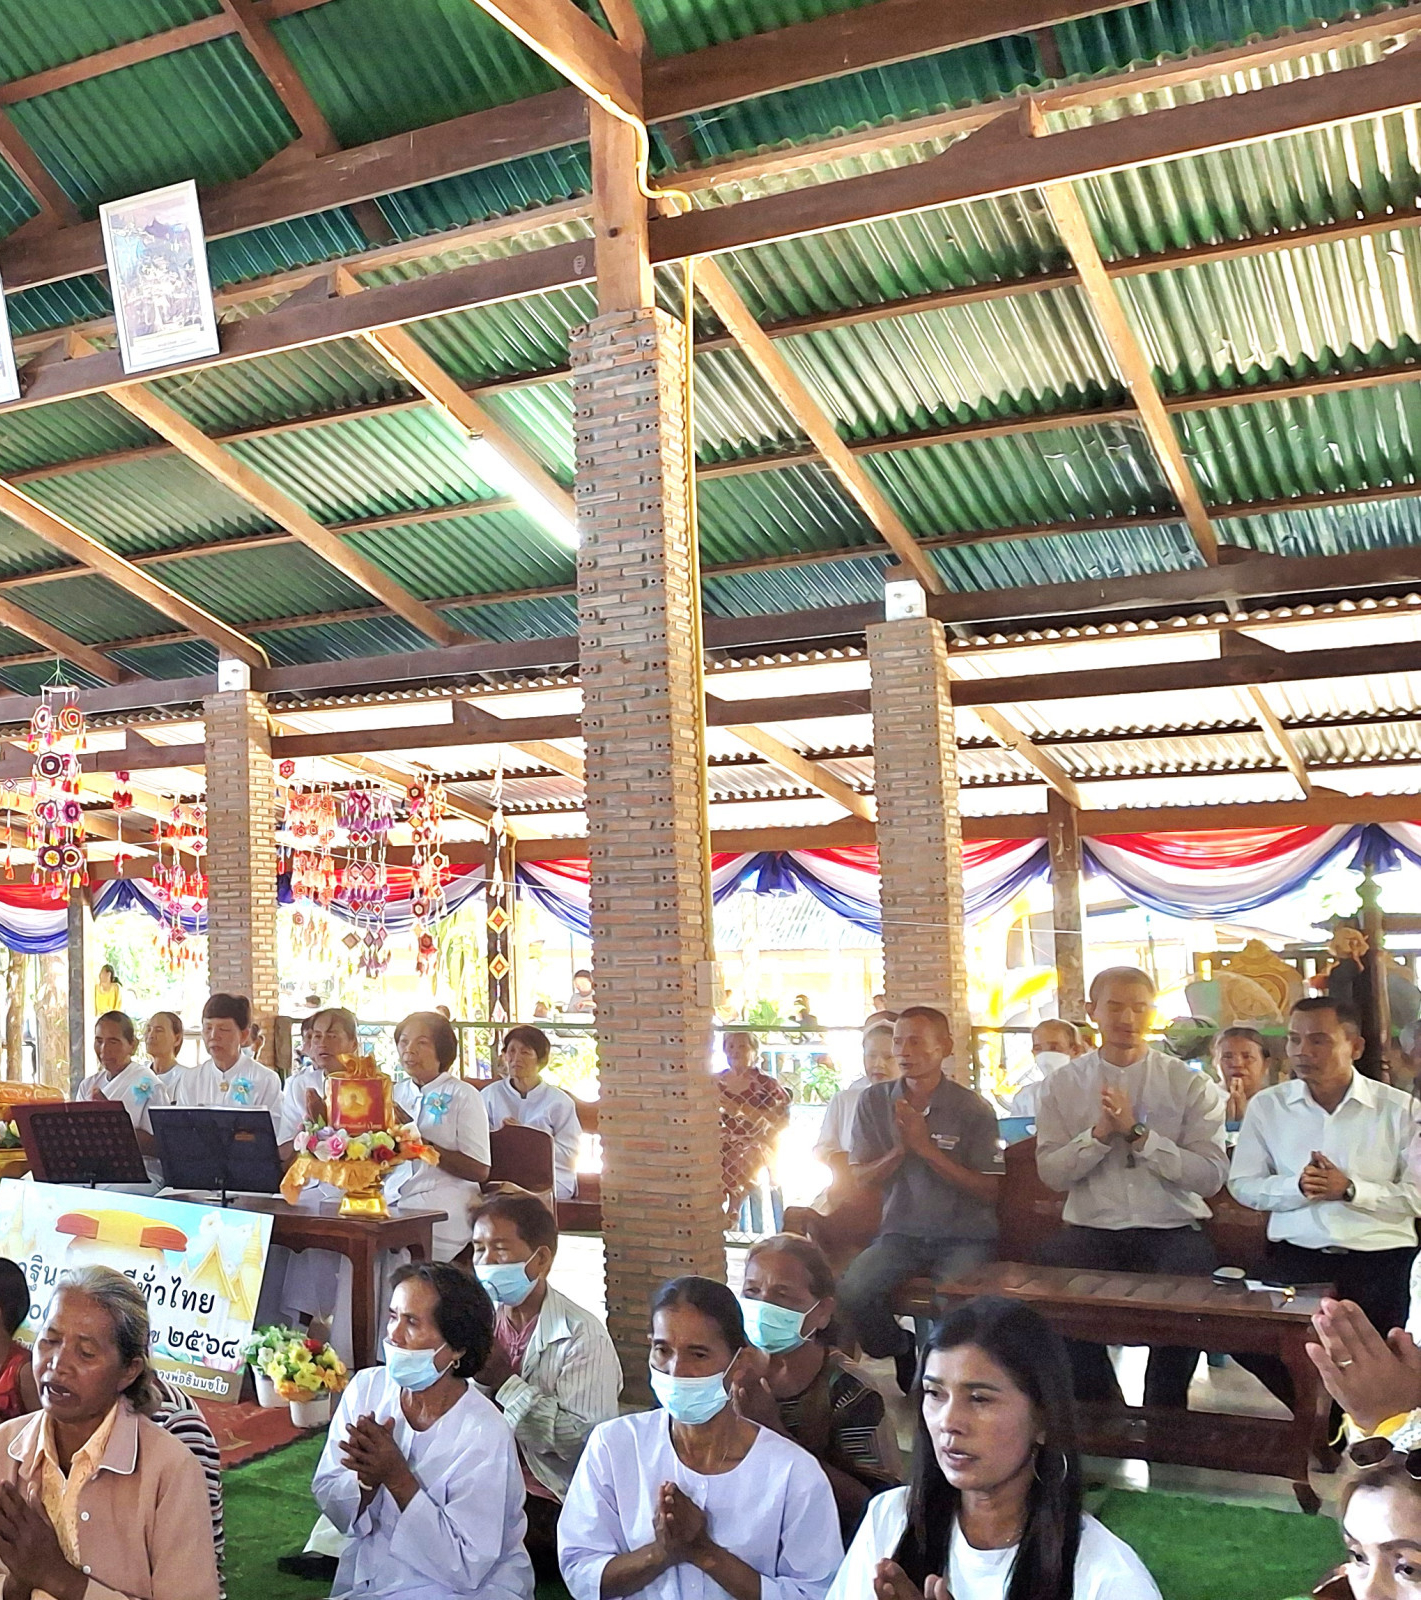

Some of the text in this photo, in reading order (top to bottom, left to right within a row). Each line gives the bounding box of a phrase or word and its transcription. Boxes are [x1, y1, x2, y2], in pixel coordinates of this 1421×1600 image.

[168, 1325, 240, 1359] ๒๕๖๘
[158, 1369, 228, 1394] วงพ่อธัมมชโย
